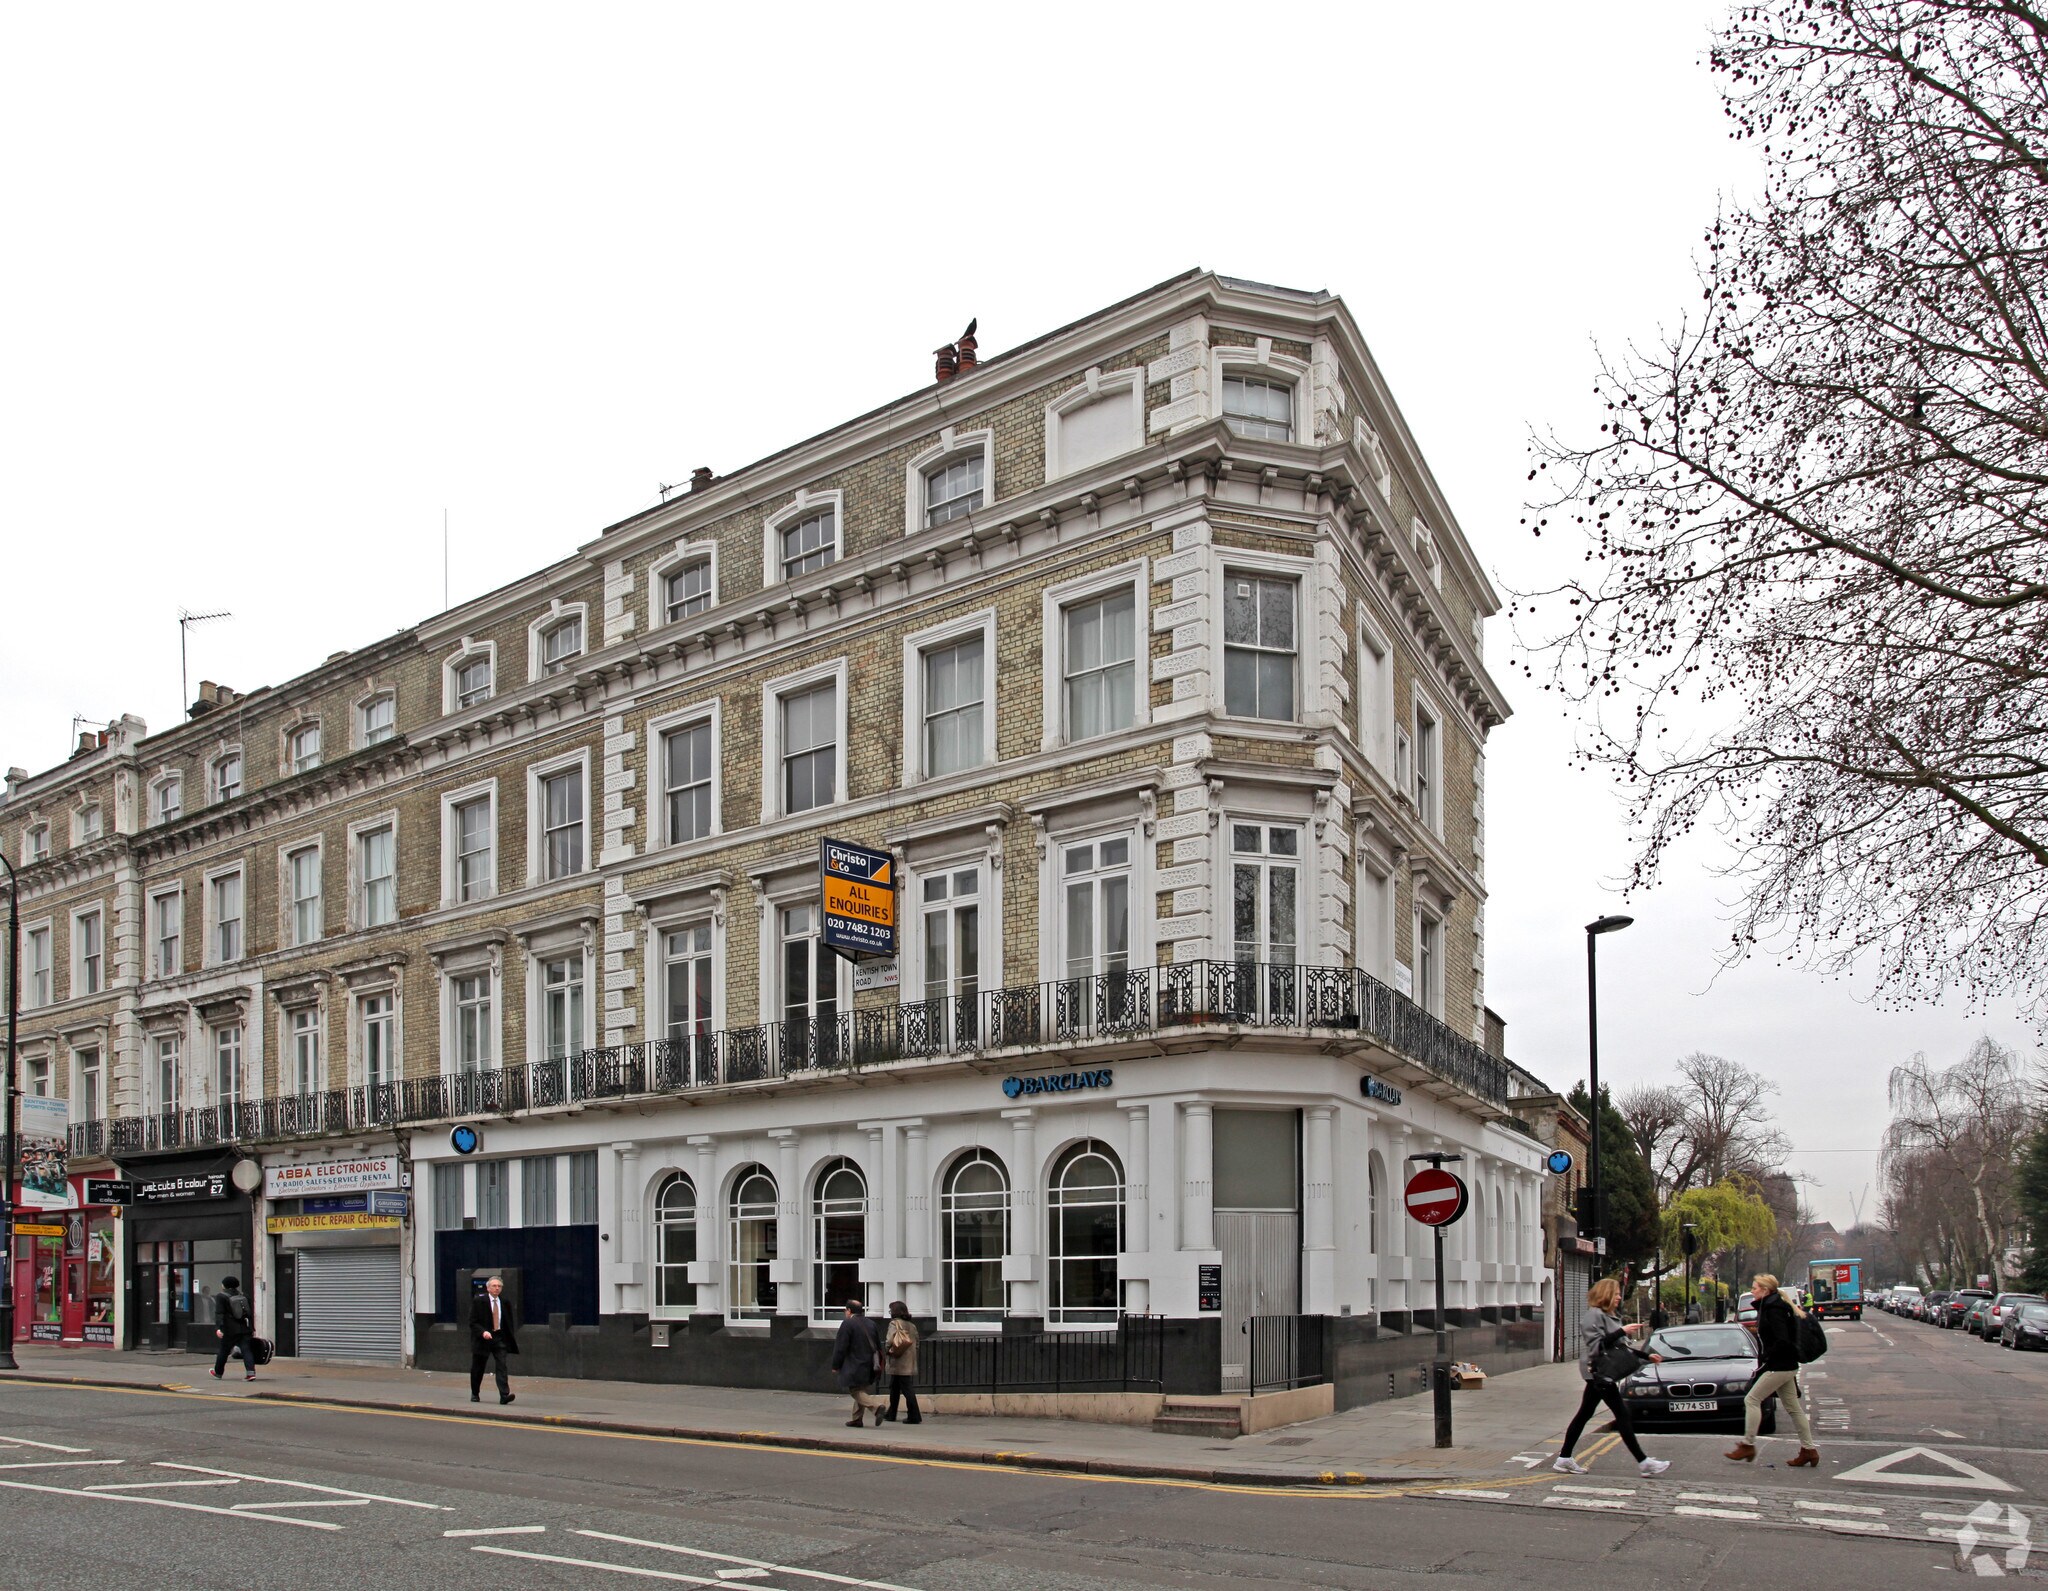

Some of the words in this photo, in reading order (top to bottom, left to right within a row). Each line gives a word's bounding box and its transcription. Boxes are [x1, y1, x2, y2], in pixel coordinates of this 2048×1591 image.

[830, 848, 867, 867] Christo
[849, 886, 870, 901] ALL
[829, 896, 889, 921] ENQUIRIES
[827, 917, 844, 930] 020
[846, 921, 868, 934] 7482
[870, 926, 891, 939] 1203
[835, 933, 883, 947] www.christo.co.uk
[855, 966, 879, 977] KENTISH
[880, 963, 898, 973] TOWN
[855, 977, 872, 987] ROAD
[884, 974, 898, 982] NW5
[1022, 1069, 1113, 1095] BARCLAYS
[277, 1168, 312, 1180] ABBA
[317, 1161, 387, 1176] ELECTRONICS
[362, 1173, 392, 1181] RENTAL
[158, 1181, 176, 1191] cuts
[184, 1178, 208, 1189] colour
[210, 1184, 223, 1194] £7
[289, 1216, 310, 1227] VIDEO
[313, 1216, 328, 1226] ETC.
[330, 1214, 355, 1225] REPAIR
[358, 1213, 388, 1224] CENTRE
[1675, 1402, 1697, 1411] X774
[1699, 1401, 1715, 1410] SBT
